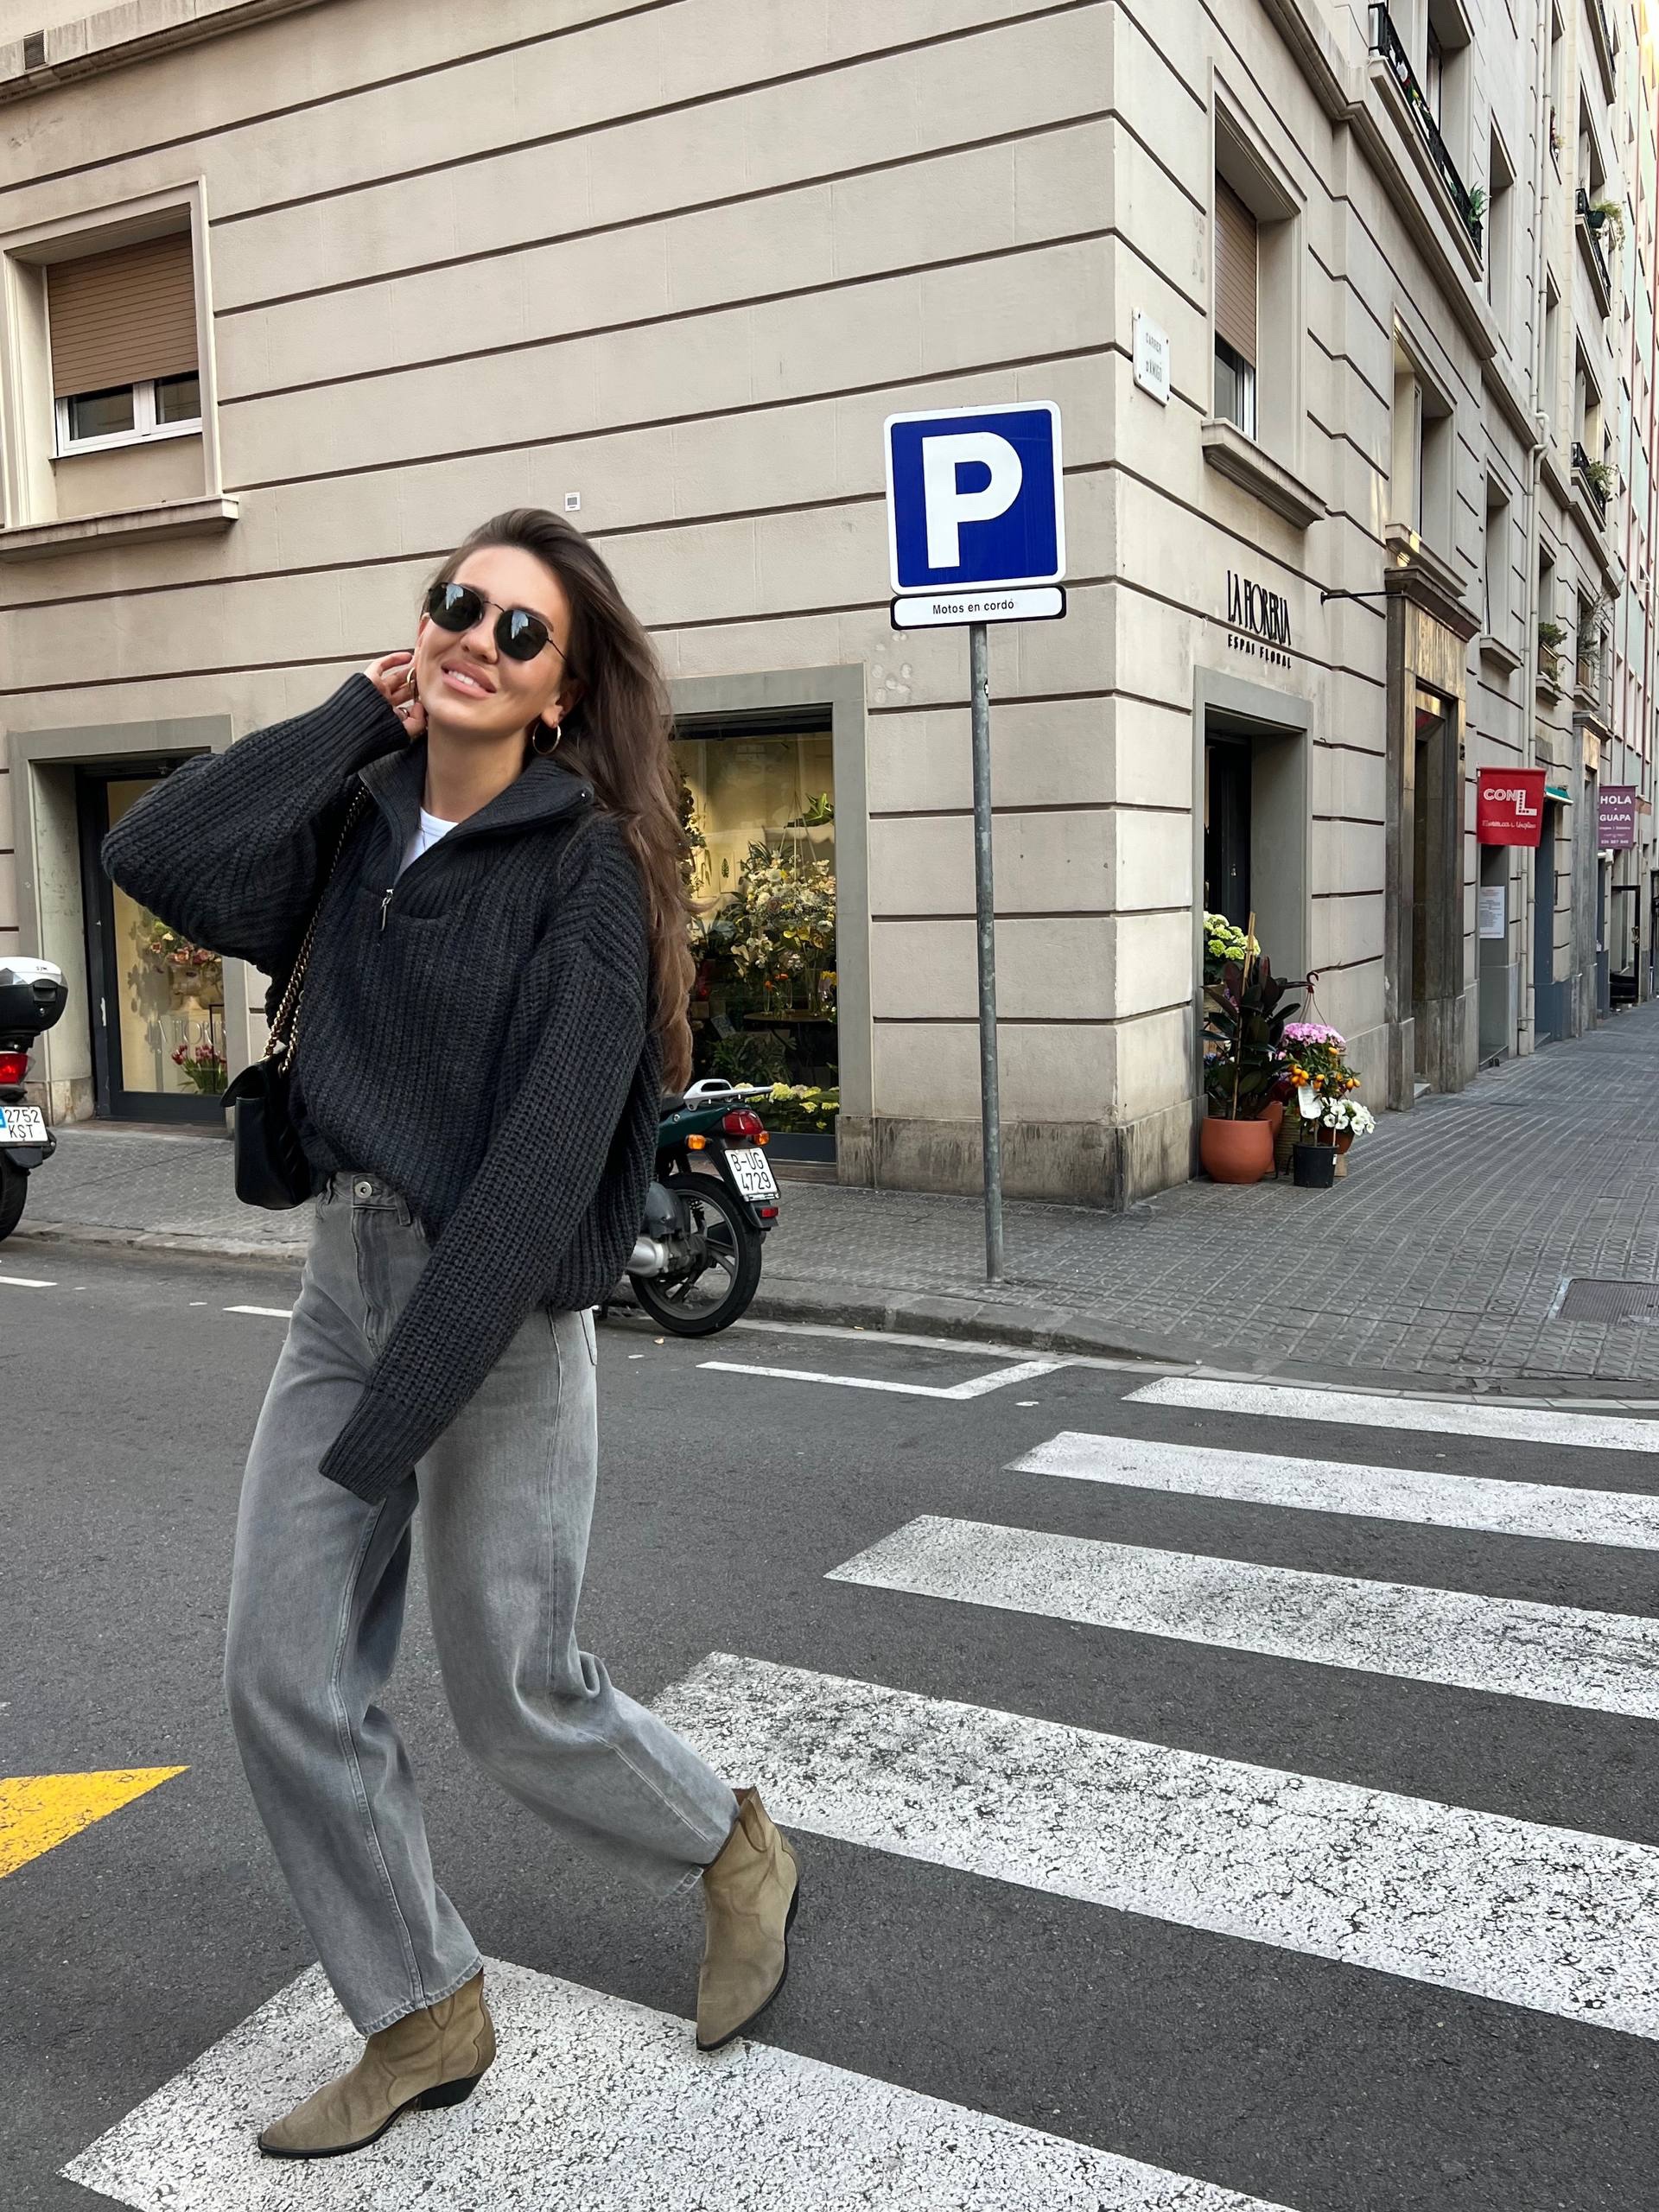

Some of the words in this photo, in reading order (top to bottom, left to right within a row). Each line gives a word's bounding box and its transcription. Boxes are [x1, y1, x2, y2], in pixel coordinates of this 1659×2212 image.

[1145, 332, 1162, 355] CARRER
[921, 431, 1023, 569] P
[932, 604, 964, 615] Motos
[968, 604, 981, 613] en
[983, 598, 1014, 612] cordó
[1227, 569, 1243, 626] LA
[1227, 632, 1255, 656] ESPAI
[1259, 645, 1292, 671] FLORAL
[1600, 795, 1632, 804] HOLA
[4, 1109, 41, 1123] 2752
[8, 1124, 34, 1138] KST
[730, 1152, 764, 1172] B-UG
[741, 1172, 772, 1192] 4729
